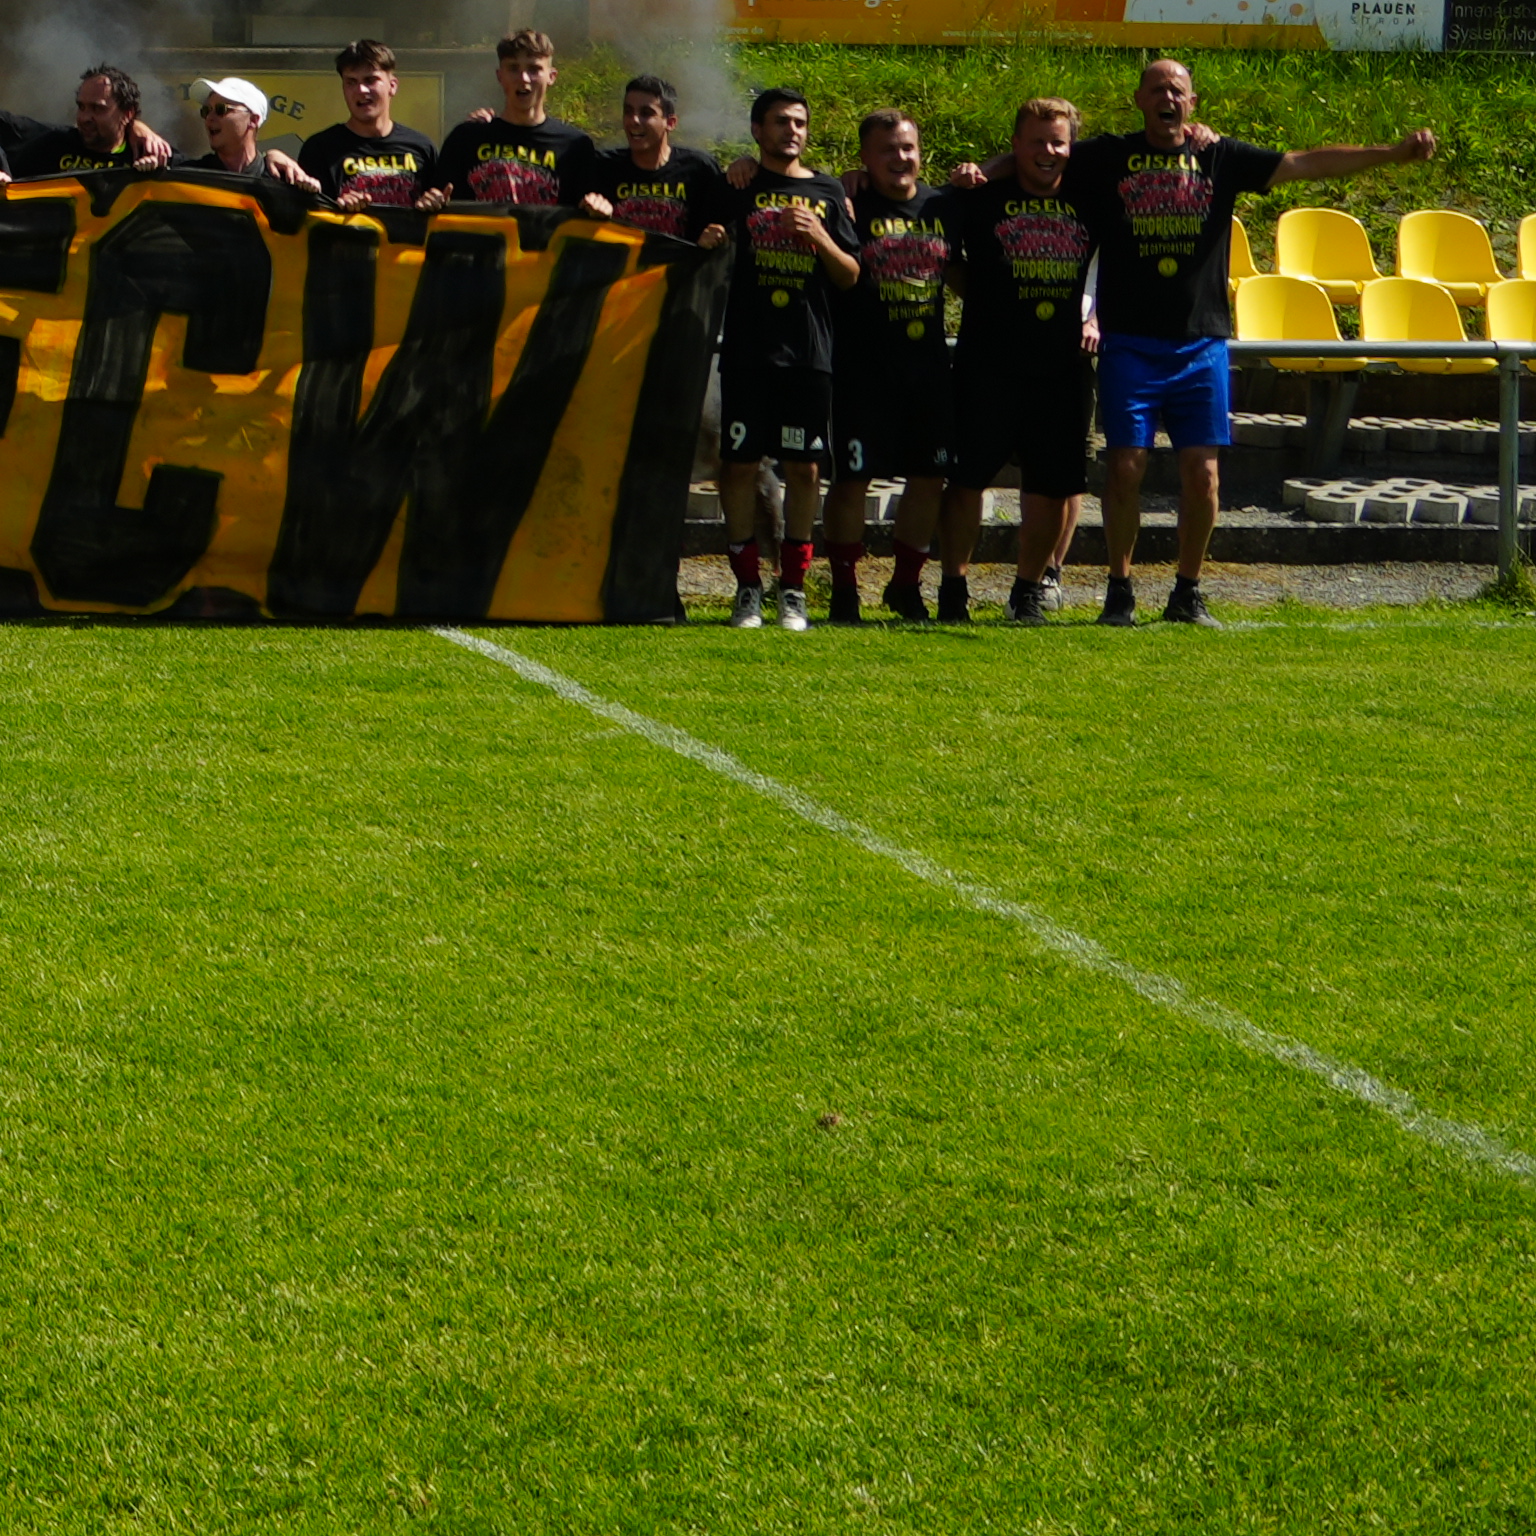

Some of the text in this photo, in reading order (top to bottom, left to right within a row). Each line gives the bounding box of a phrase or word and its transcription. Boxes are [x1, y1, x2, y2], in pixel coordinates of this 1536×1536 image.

[1351, 2, 1416, 15] PLAUEN
[343, 152, 418, 177] GISELA
[476, 142, 556, 169] GISELA
[616, 181, 687, 202] GISELA
[1004, 198, 1079, 219] GISELA
[729, 421, 747, 451] 9
[782, 426, 805, 446] JB
[847, 438, 864, 472] 3
